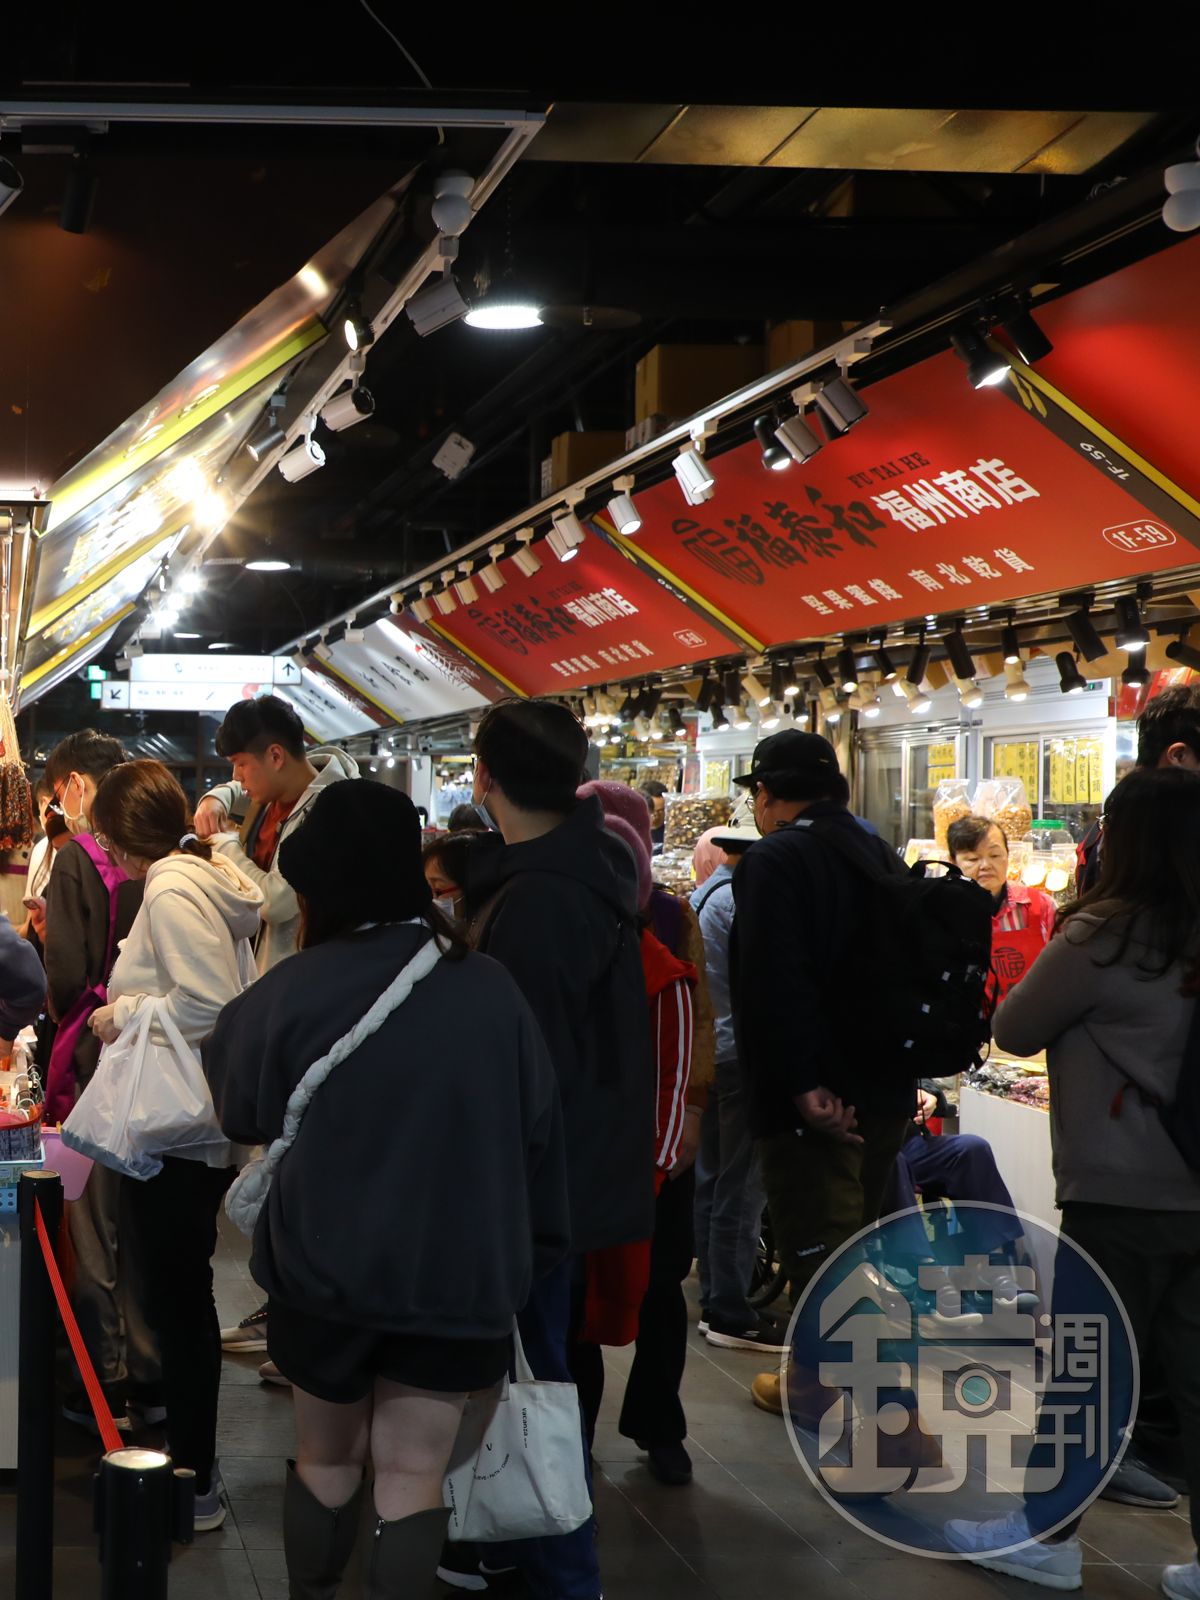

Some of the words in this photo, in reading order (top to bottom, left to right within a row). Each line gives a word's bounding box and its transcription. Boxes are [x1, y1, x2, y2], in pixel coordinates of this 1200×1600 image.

[848, 473, 872, 489] FU
[872, 461, 902, 483] TAI
[898, 450, 931, 474] HE
[869, 457, 1041, 533] 福州商店
[1112, 523, 1165, 550] 1F-59
